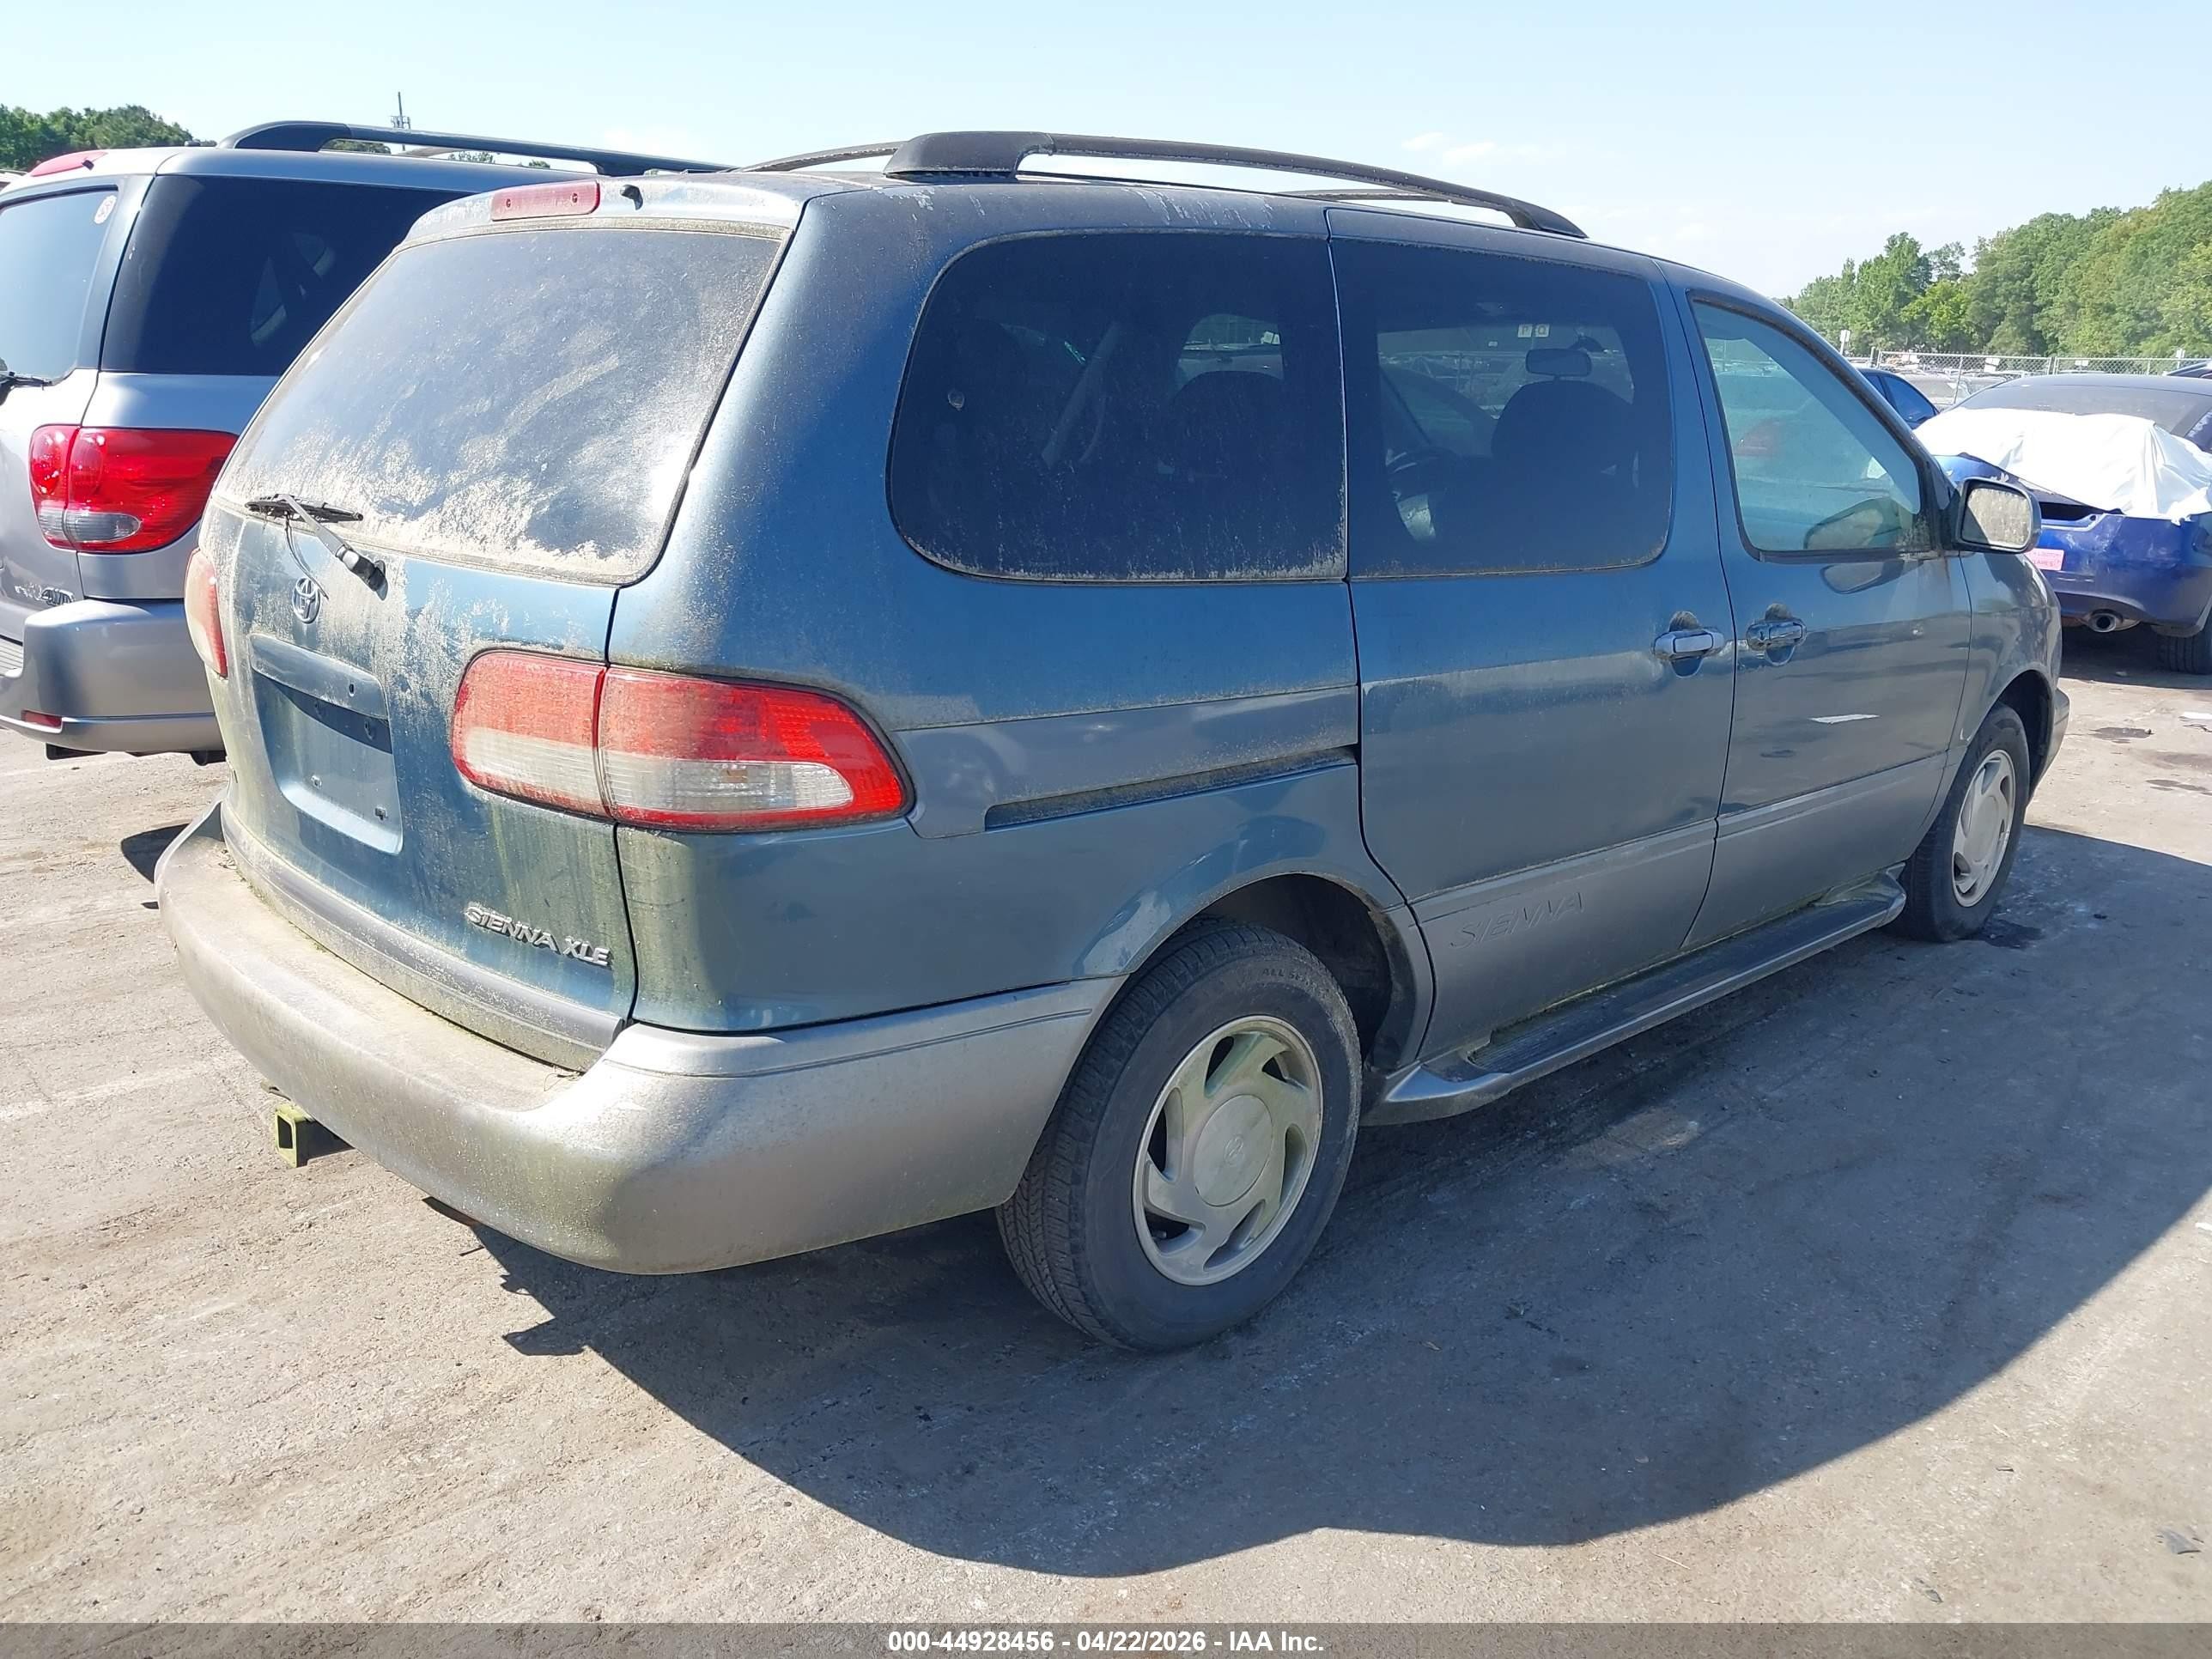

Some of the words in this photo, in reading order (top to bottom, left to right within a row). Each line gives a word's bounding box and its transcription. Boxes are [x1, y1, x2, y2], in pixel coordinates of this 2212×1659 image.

[465, 903, 561, 954] SIENNA
[562, 936, 613, 968] XLE
[1447, 892, 1585, 948] SIENNA
